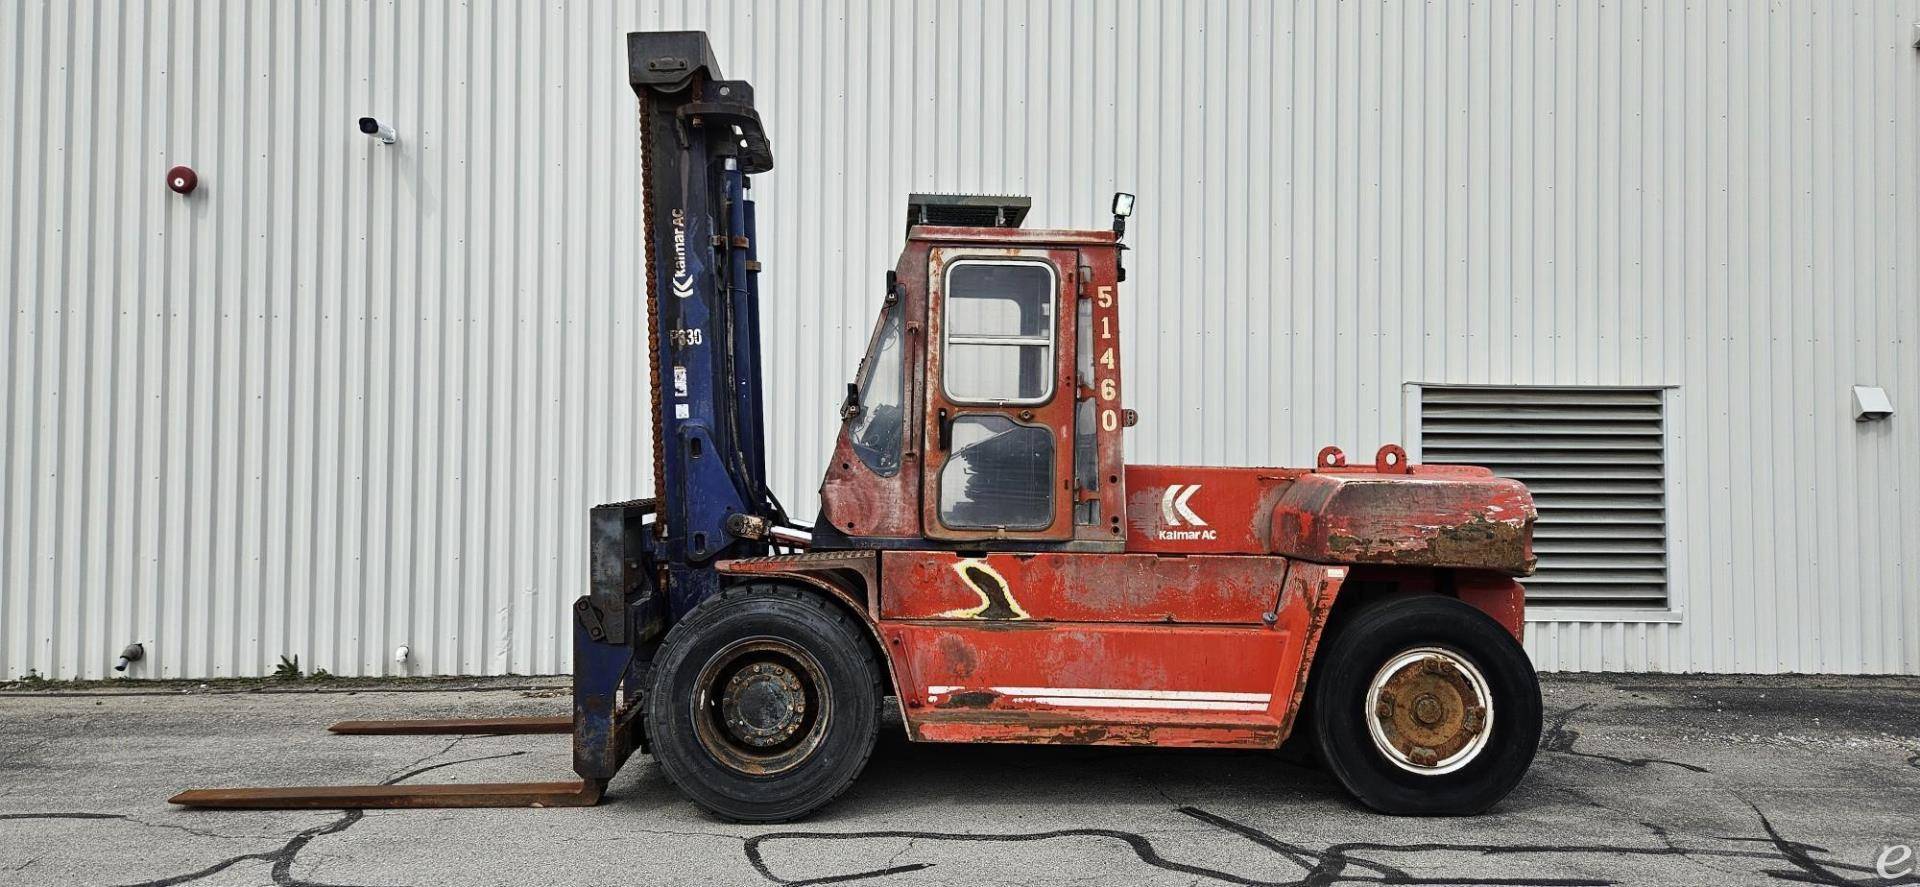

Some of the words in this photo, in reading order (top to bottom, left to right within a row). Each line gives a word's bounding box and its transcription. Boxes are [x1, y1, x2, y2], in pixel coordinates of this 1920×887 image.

[1097, 286, 1118, 432] 51460
[1159, 530, 1200, 540] Kalmar
[1201, 530, 1217, 540] AC
